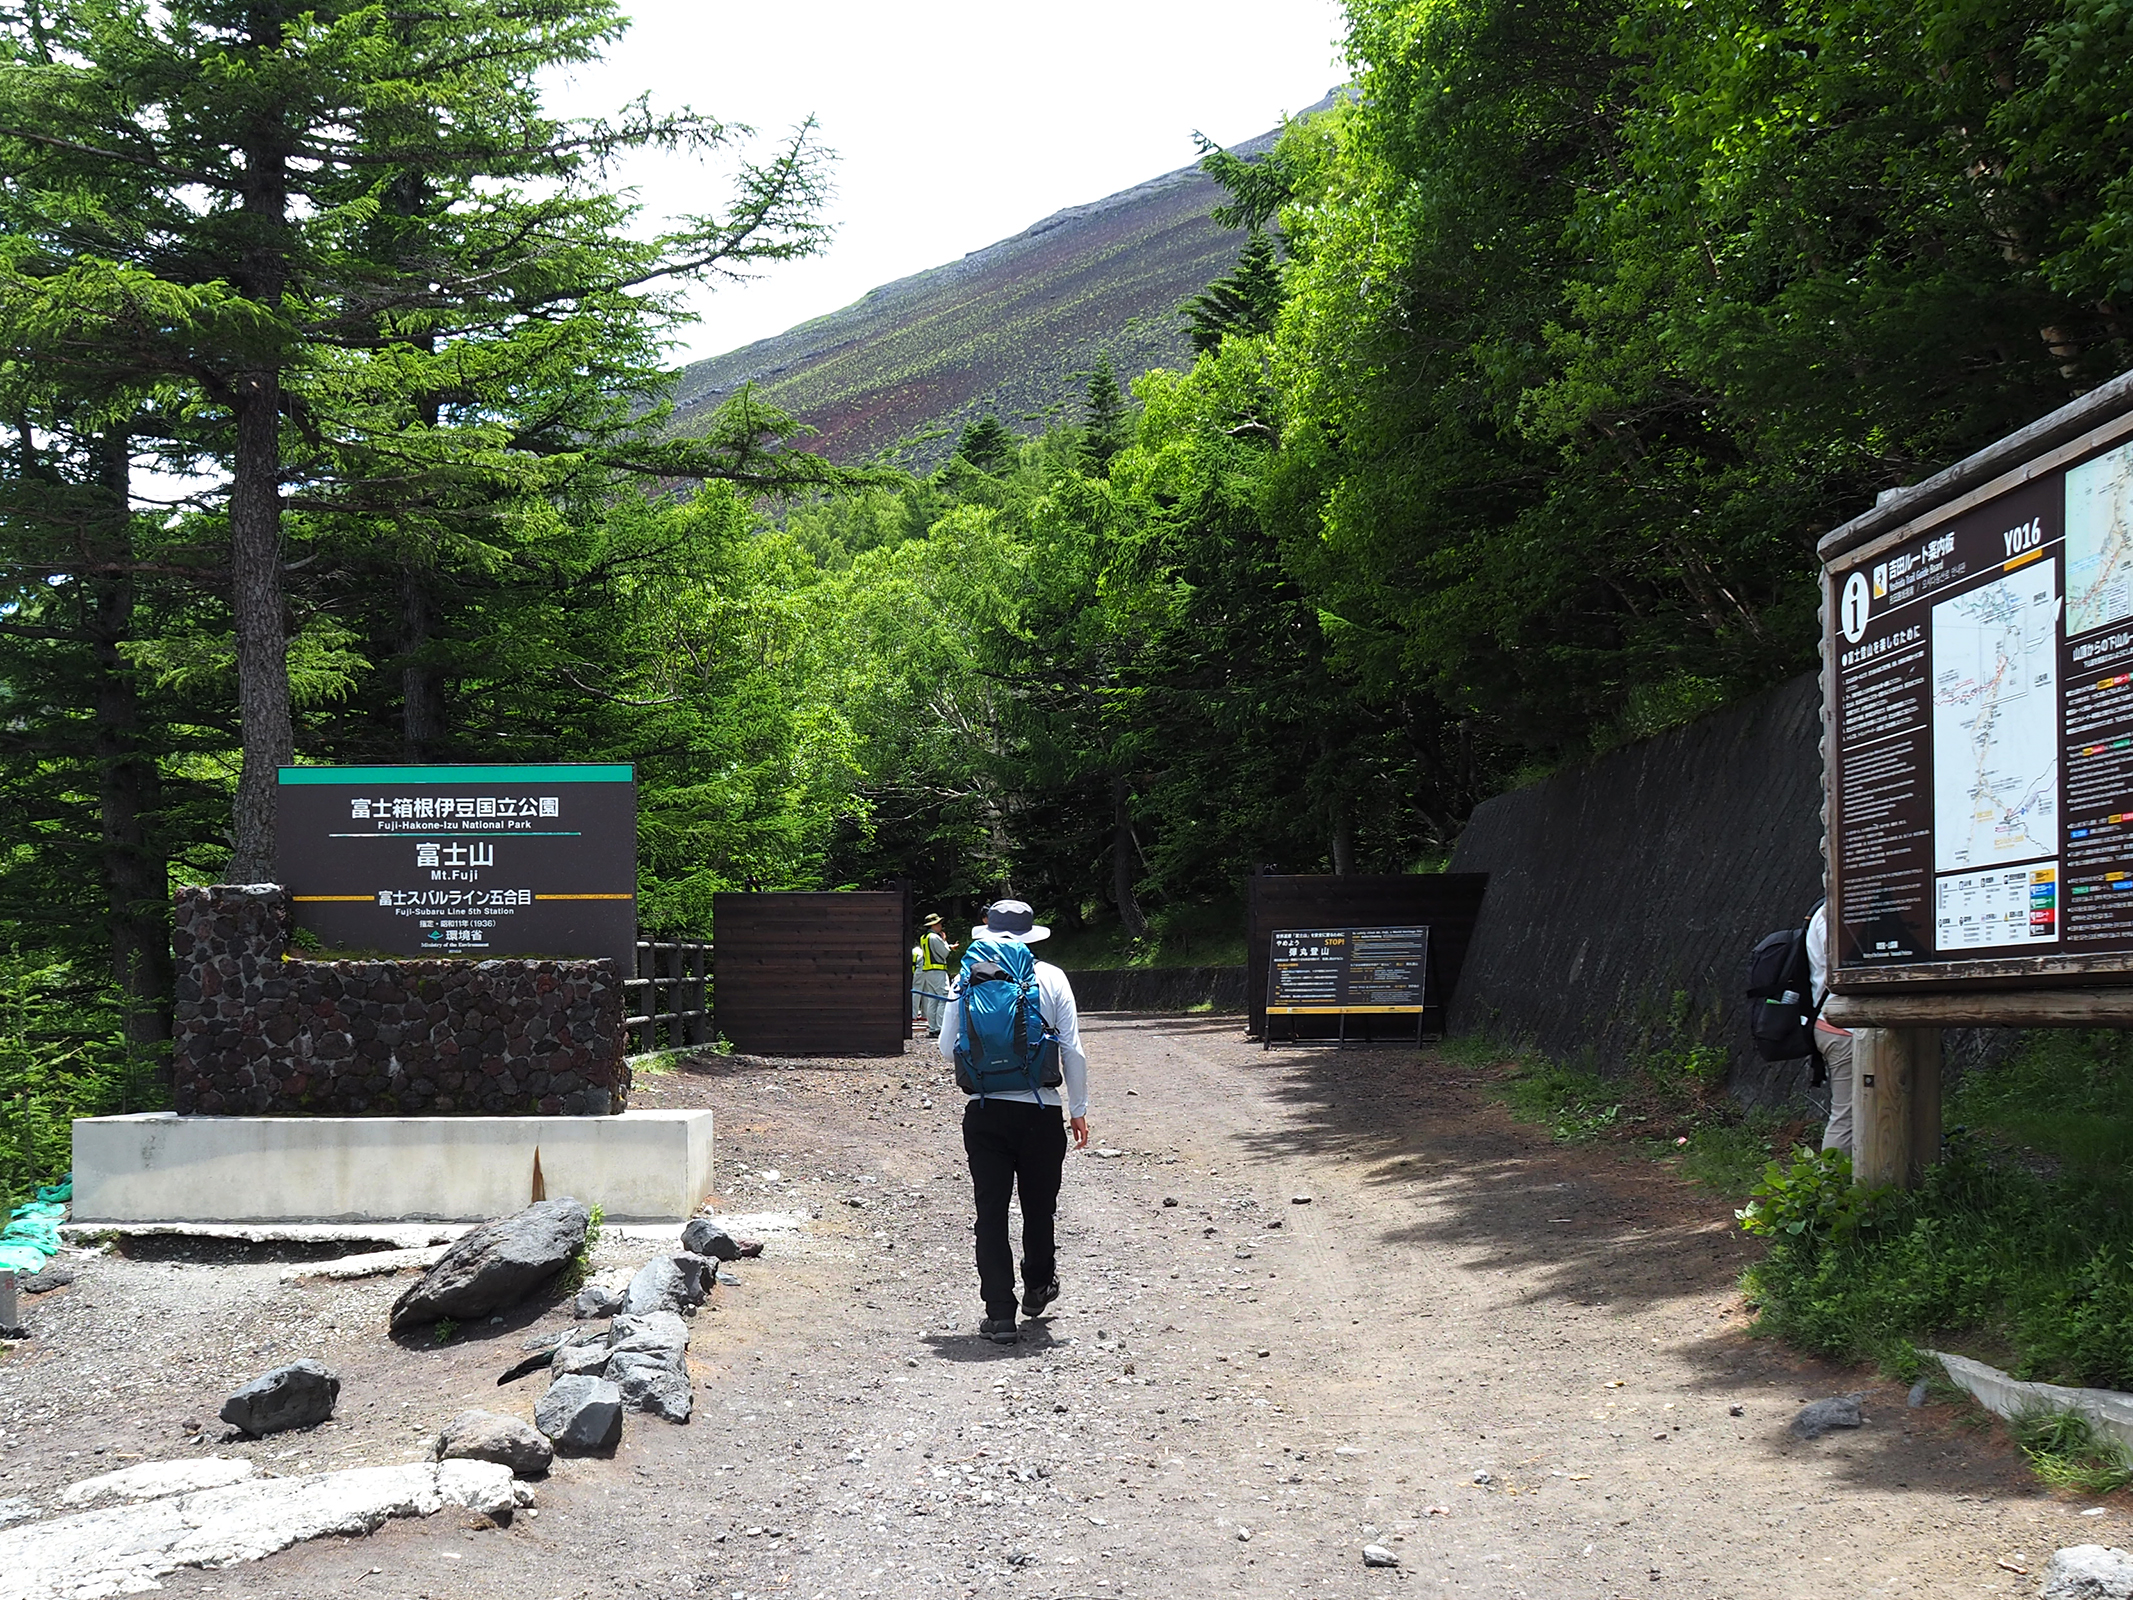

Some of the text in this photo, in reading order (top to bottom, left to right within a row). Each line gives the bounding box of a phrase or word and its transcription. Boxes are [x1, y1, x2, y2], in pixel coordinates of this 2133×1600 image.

[2003, 517, 2042, 557] Y016
[1888, 531, 1955, 580] 吉田ルート案内板
[1889, 559, 1944, 592] Yoshida Trail Guide Board
[350, 797, 559, 819] 富士箱根伊豆国立公園
[377, 820, 532, 831] Fuji-Hakone-Izu National Park
[415, 842, 494, 868] 富士山
[430, 870, 479, 883] Mt.Fuji
[378, 889, 532, 907] 富士スバルライン五合目
[395, 907, 515, 917] Fuji-Subaru Line 5th Station
[445, 929, 483, 942] 環境省
[1276, 939, 1300, 947] やめよう
[1324, 938, 1345, 946] STOP!
